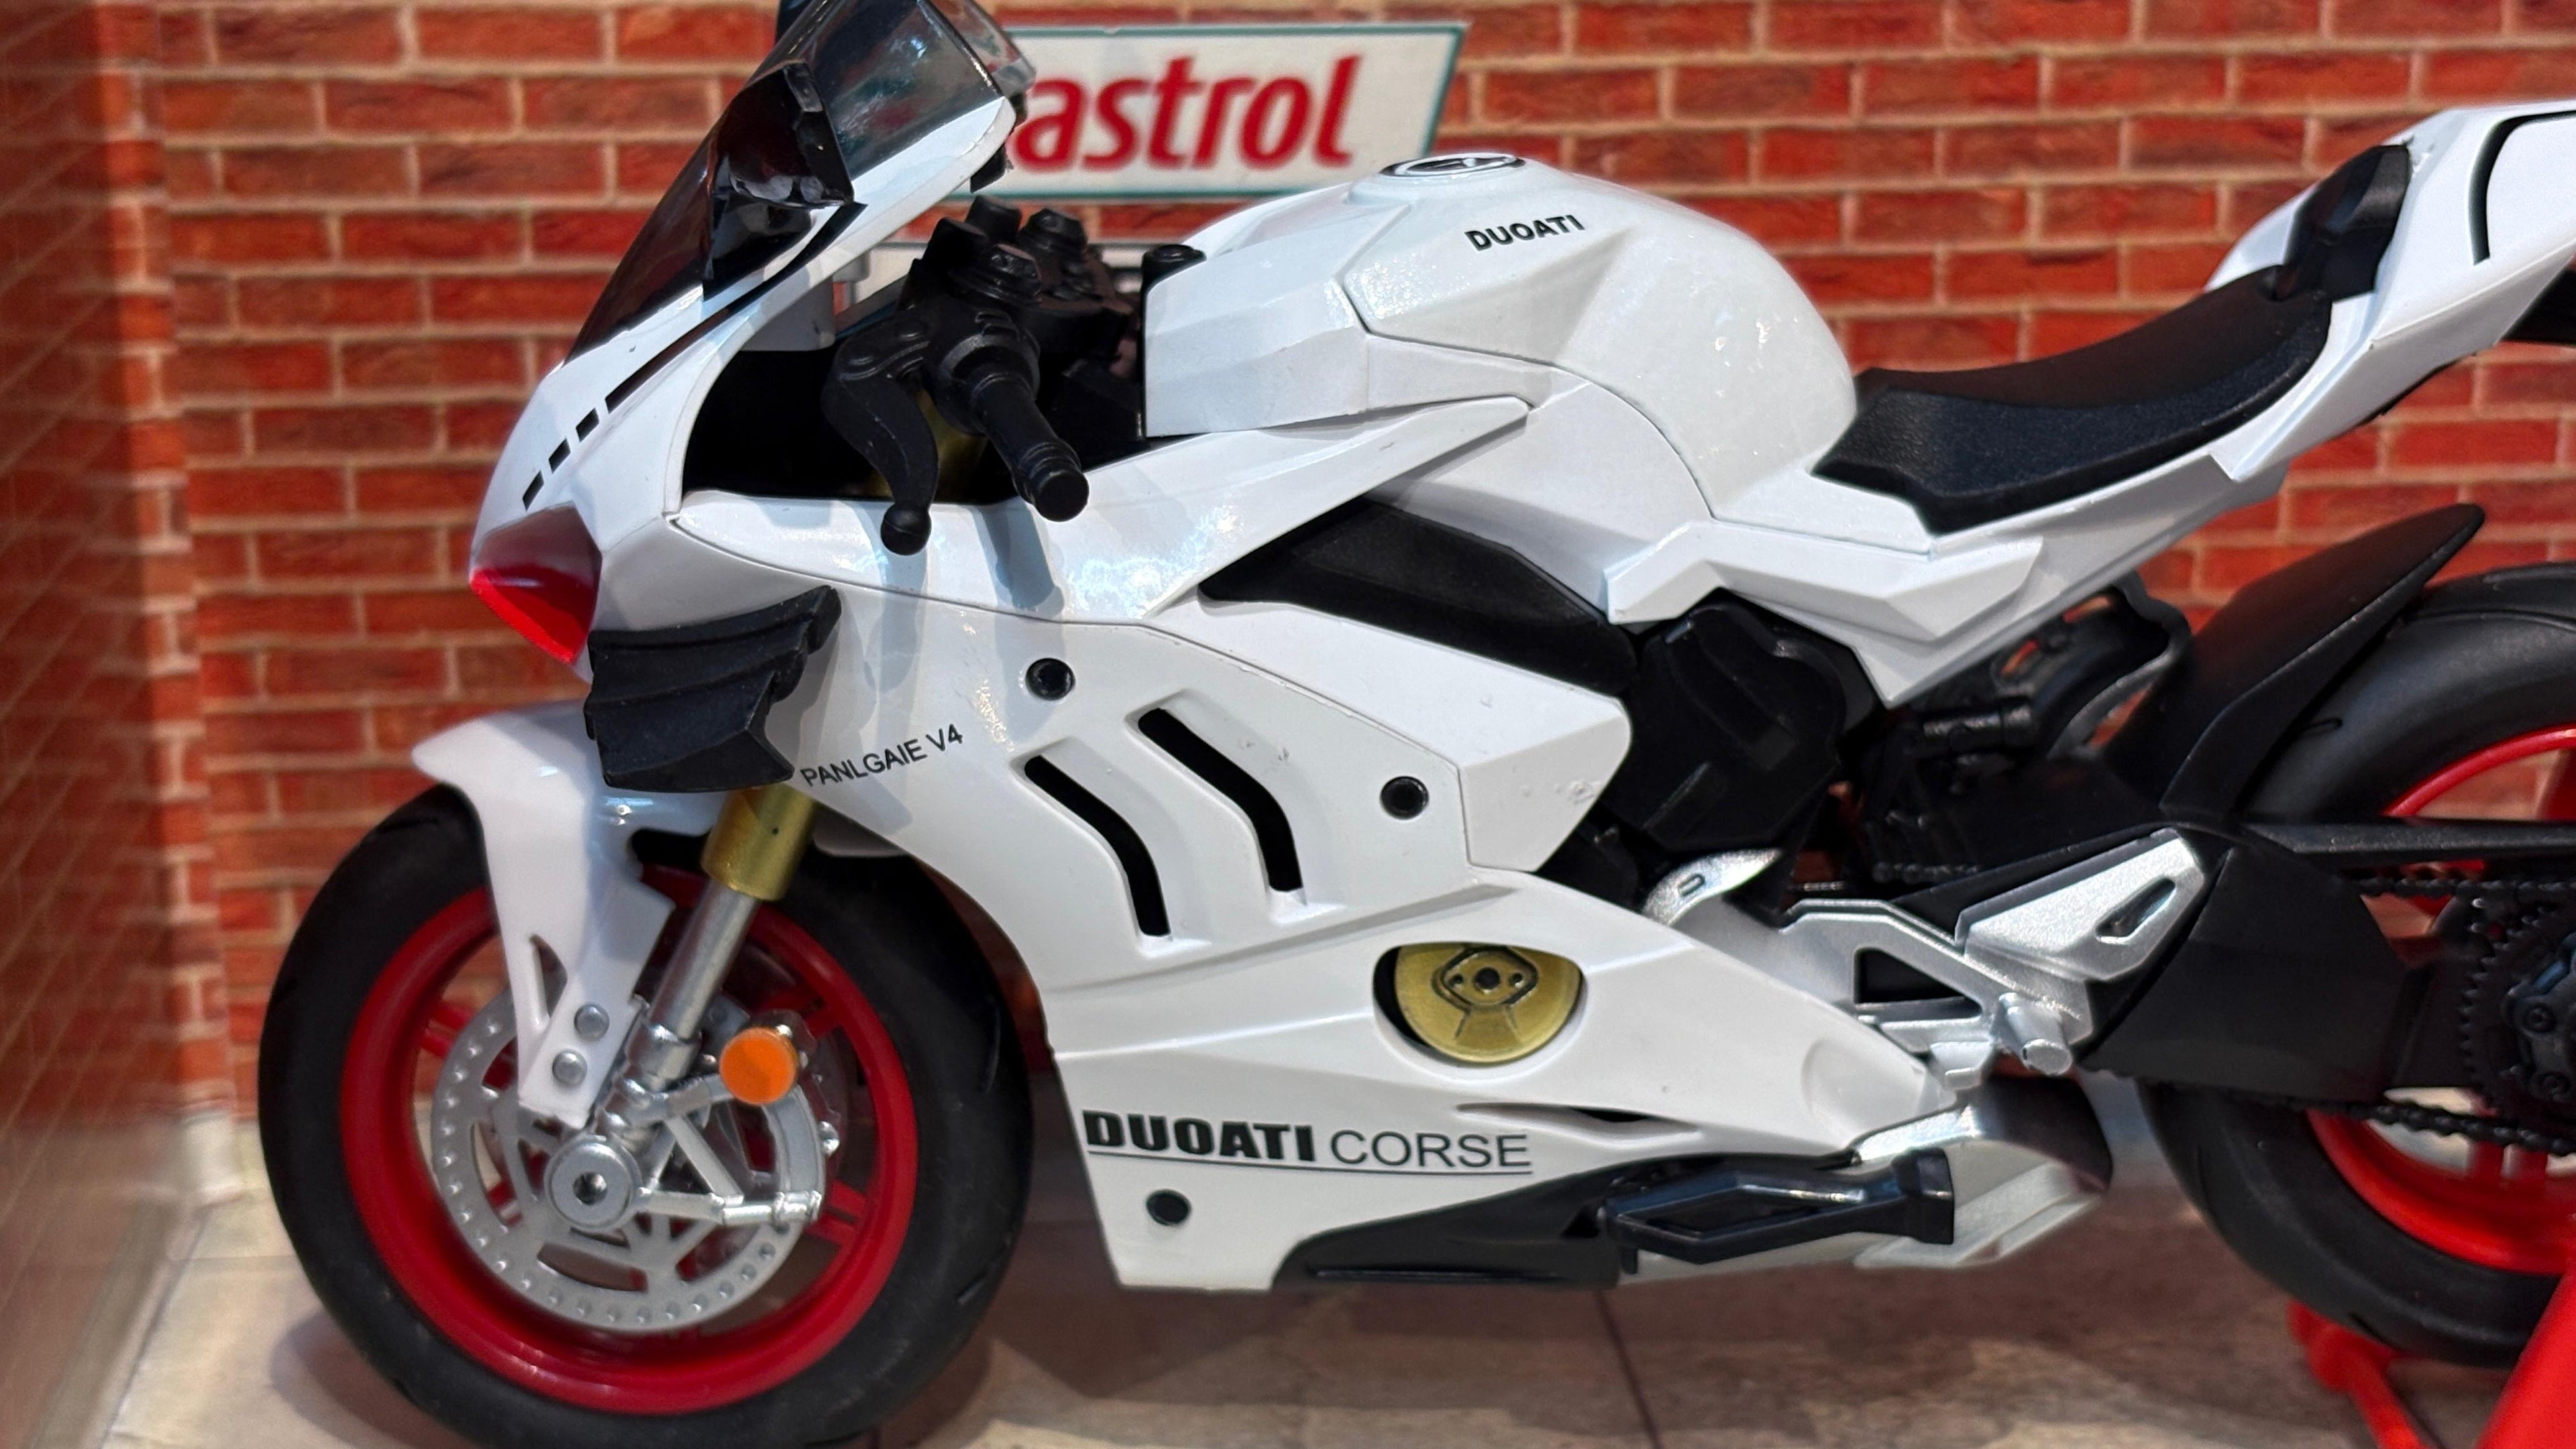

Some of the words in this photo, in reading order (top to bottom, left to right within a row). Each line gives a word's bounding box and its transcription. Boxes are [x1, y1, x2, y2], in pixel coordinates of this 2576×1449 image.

[1007, 55, 1359, 171] astrol
[1464, 214, 1585, 252] DUOATI
[800, 739, 928, 788] PANLGAIE
[925, 724, 963, 752] V4
[1082, 1110, 1317, 1163] DUOATI
[1330, 1129, 1532, 1168] CORSE
